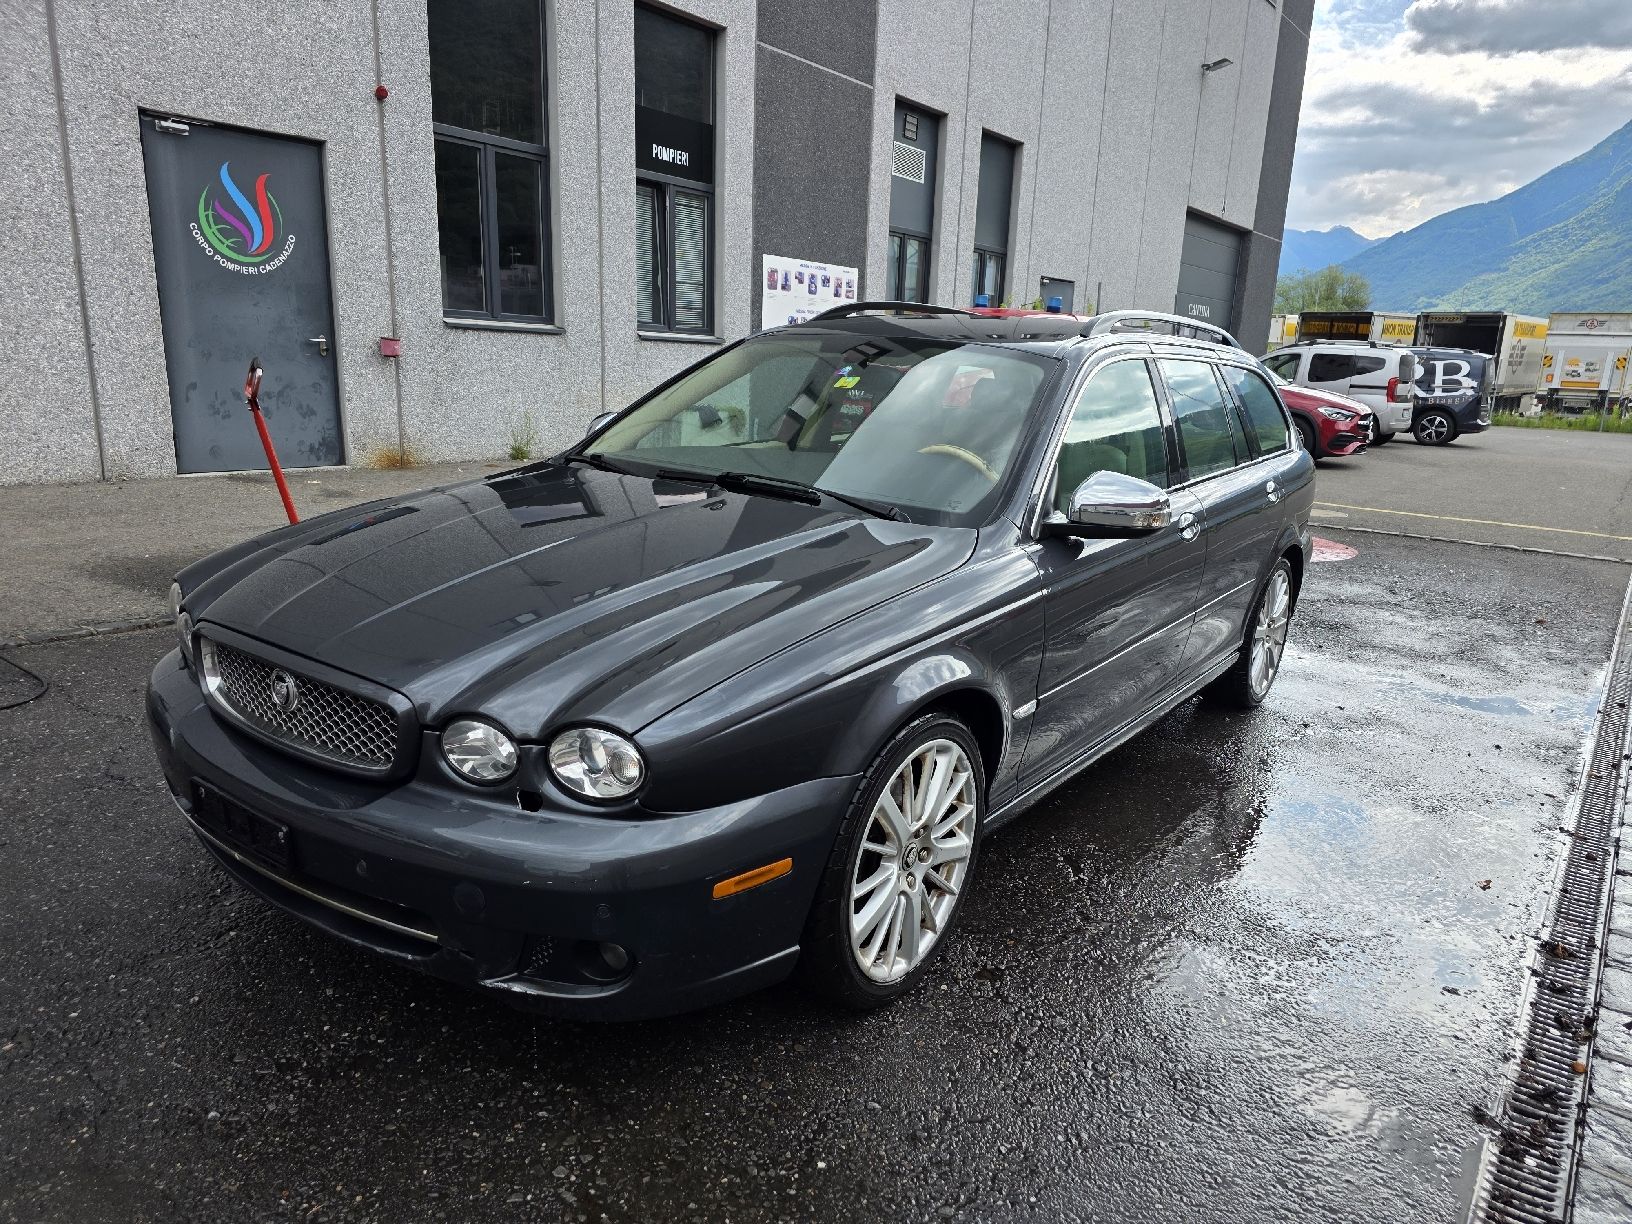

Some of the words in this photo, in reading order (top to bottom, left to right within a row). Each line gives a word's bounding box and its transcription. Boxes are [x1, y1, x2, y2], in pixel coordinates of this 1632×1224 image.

[653, 143, 689, 167] POMPIERI
[189, 222, 214, 256] CORPO
[213, 253, 258, 275] POMPIERI
[259, 234, 296, 275] CADENAZZO
